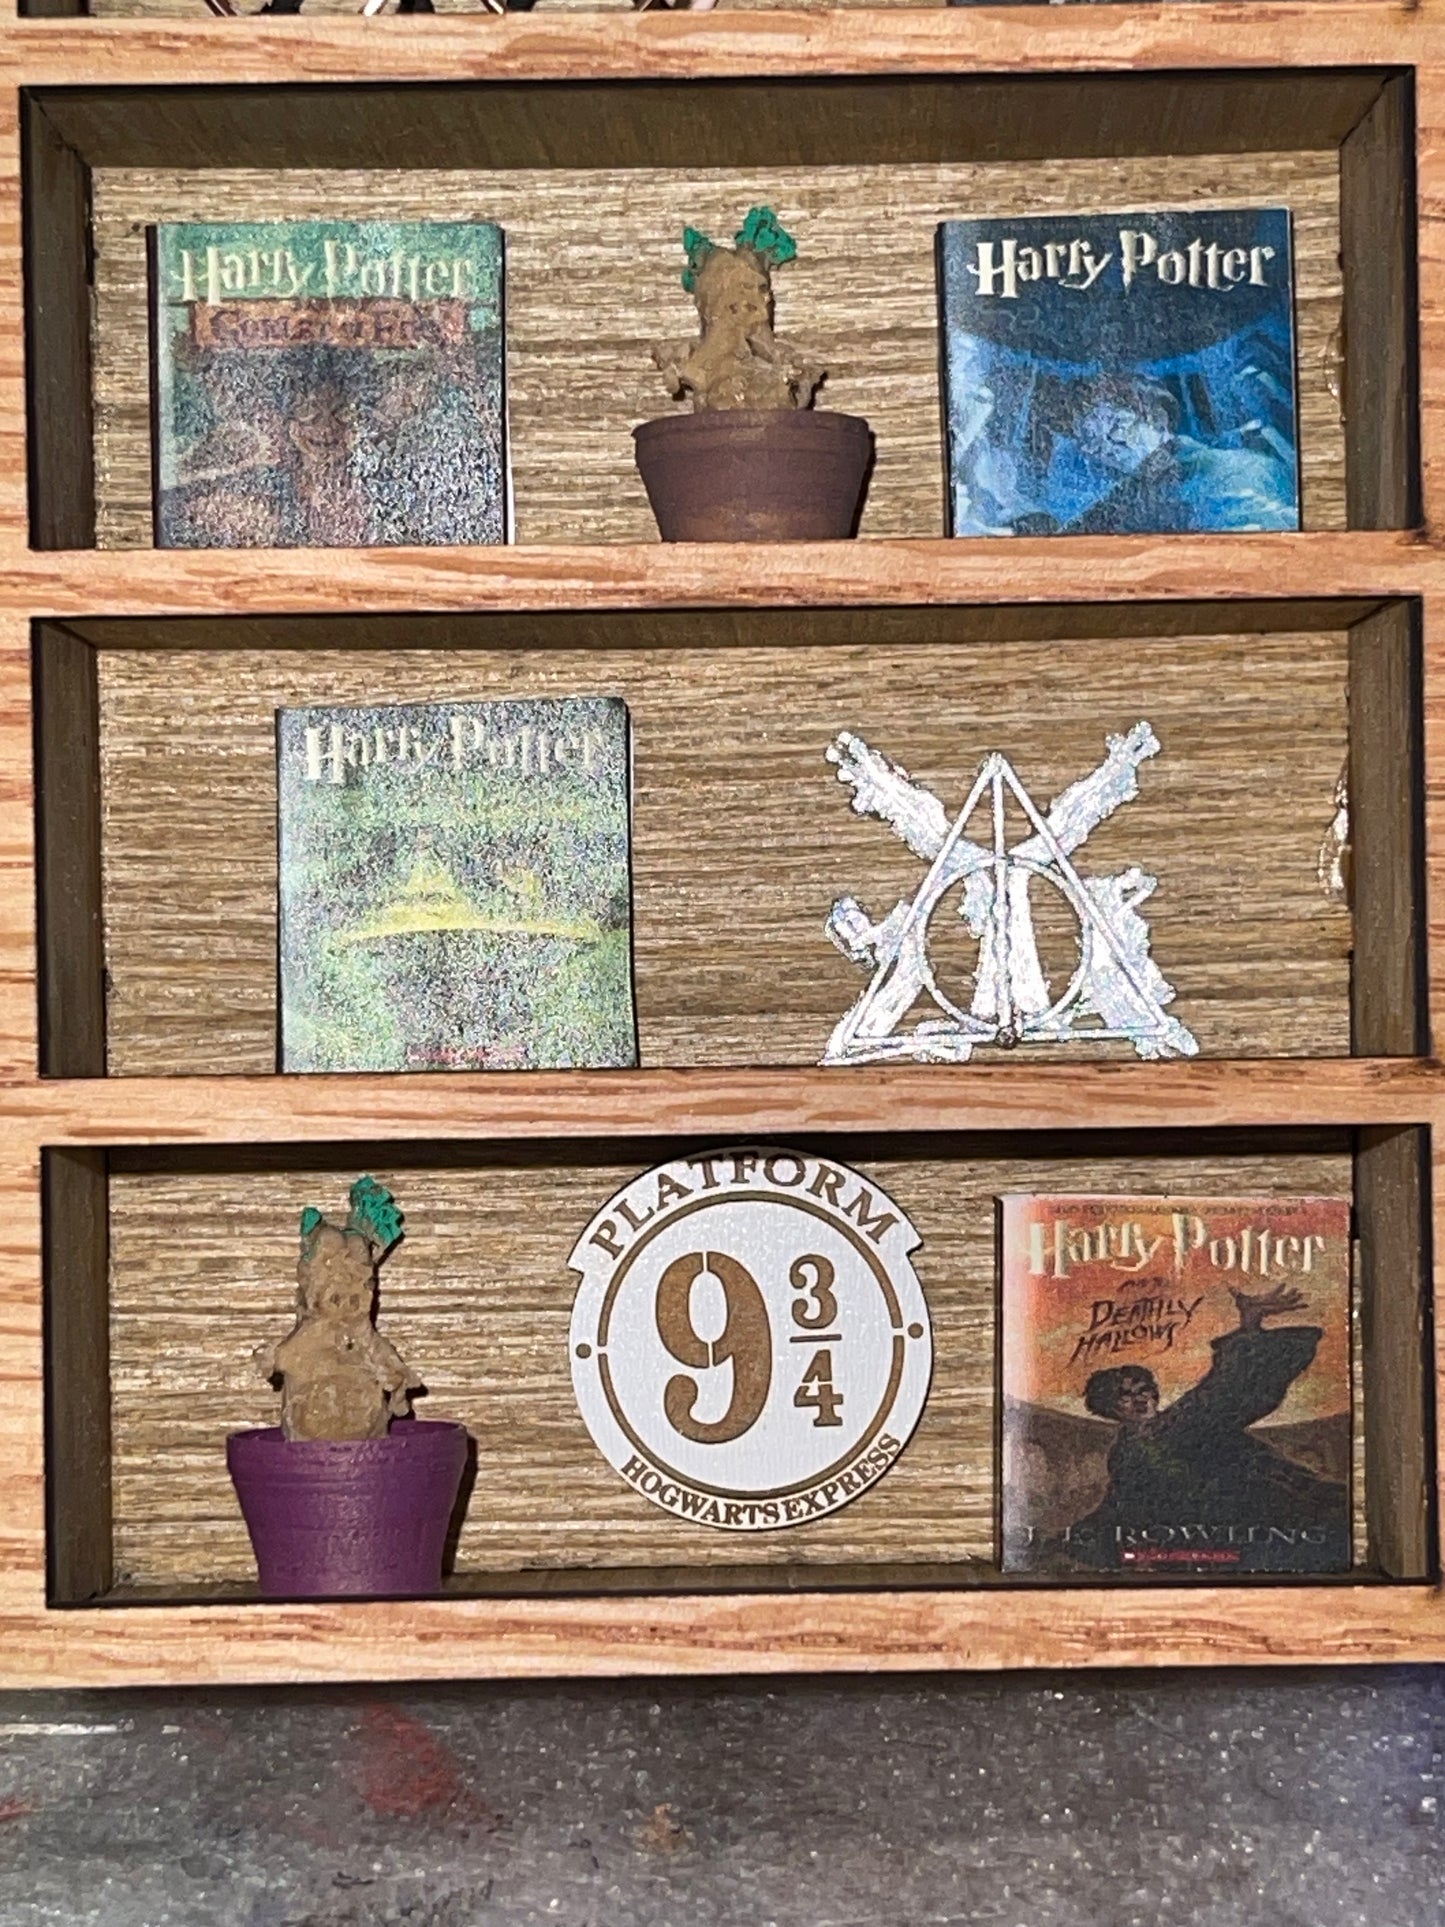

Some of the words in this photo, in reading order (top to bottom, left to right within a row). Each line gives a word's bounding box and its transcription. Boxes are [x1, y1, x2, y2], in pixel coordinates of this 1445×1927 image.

[170, 246, 316, 306] Harry
[323, 239, 473, 304] Potter
[966, 237, 1113, 299] Harry
[1119, 230, 1277, 295] Potter
[303, 723, 446, 784] Harry
[452, 715, 604, 776] Potter
[589, 1150, 899, 1261] PLATFORM
[1028, 1220, 1166, 1279] Harry
[1172, 1213, 1325, 1278] Potter
[655, 1250, 773, 1445] 9
[1067, 1322, 1180, 1366] HALLOWS
[1084, 1296, 1204, 1333] DEATHLY
[621, 1454, 780, 1526] HOGWARTS
[784, 1433, 901, 1521] EXPRESS
[1115, 1524, 1328, 1545] ROWLING
